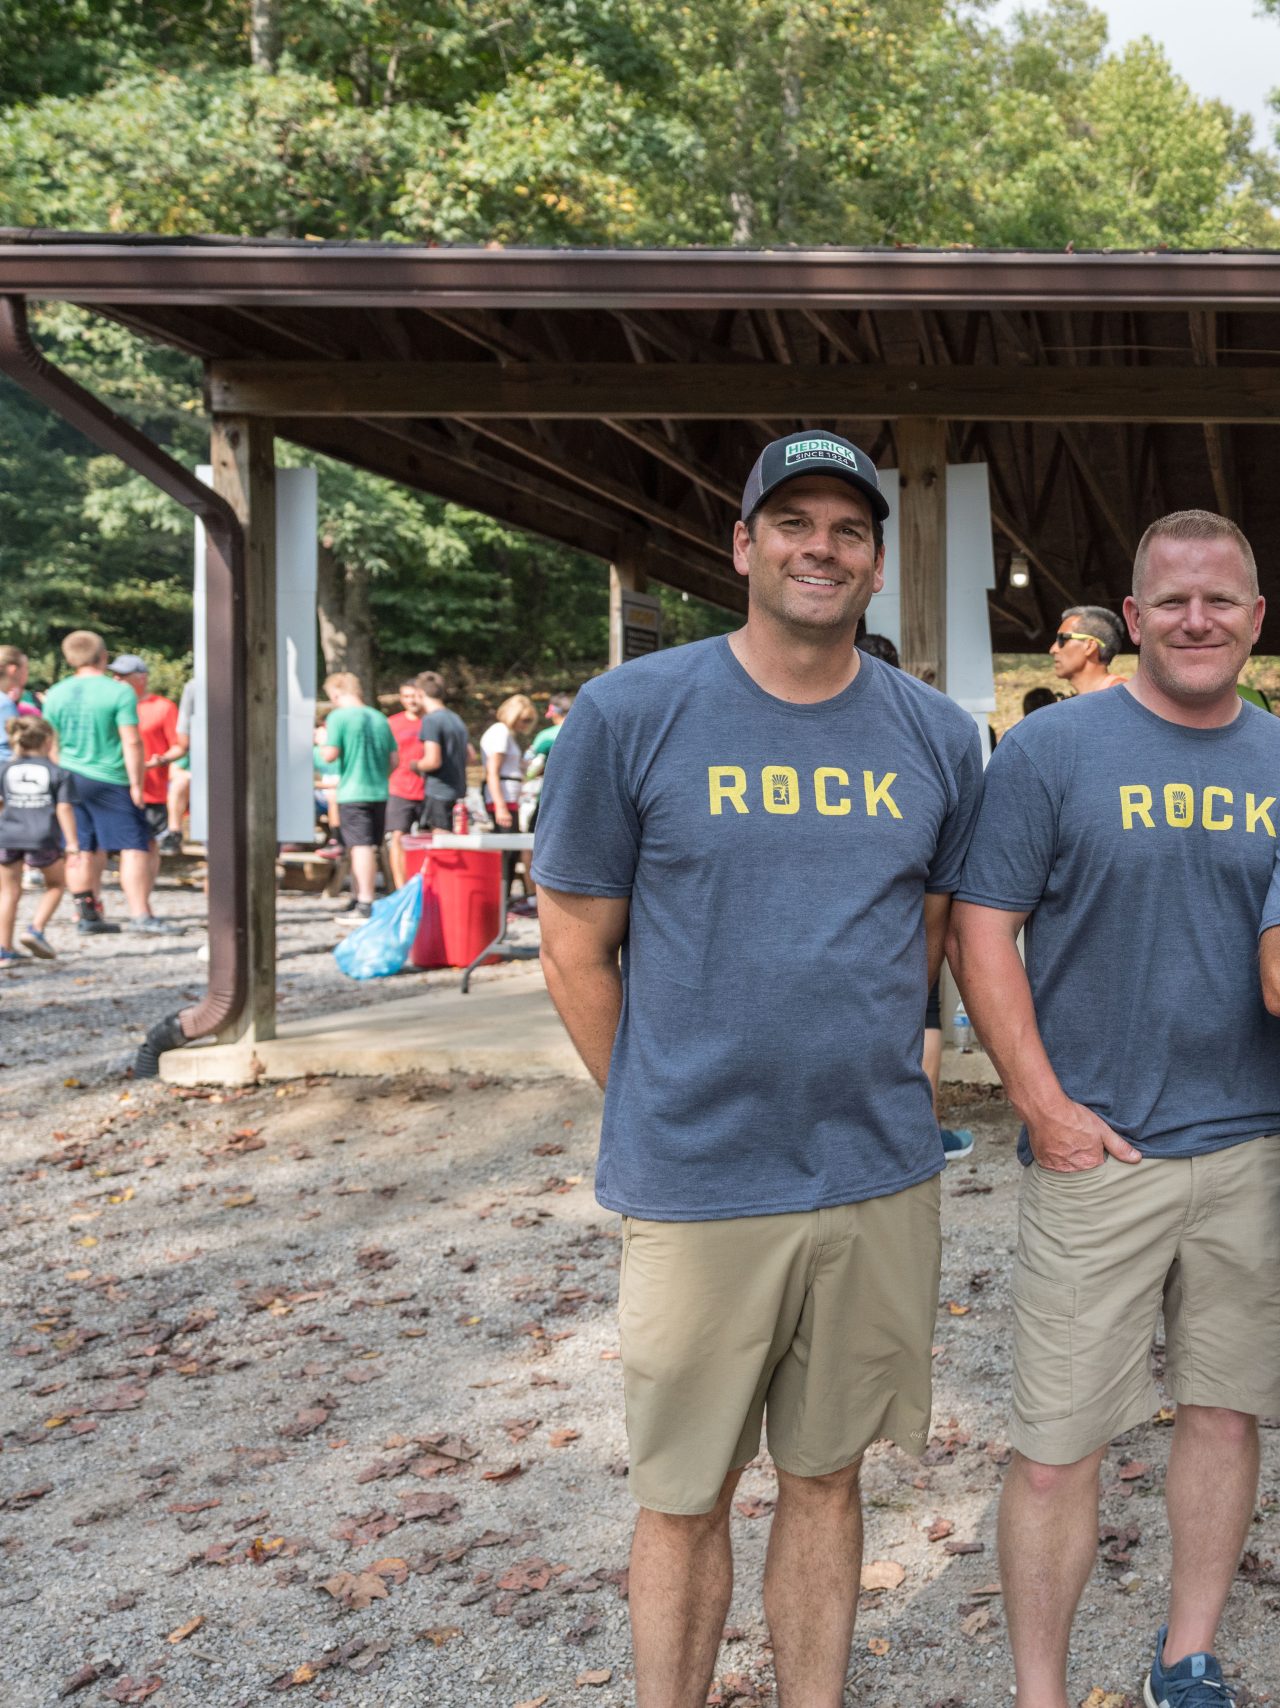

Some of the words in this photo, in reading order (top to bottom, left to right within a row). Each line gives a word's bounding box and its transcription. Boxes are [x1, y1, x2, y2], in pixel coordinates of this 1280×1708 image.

[788, 441, 853, 459] HEDRICK
[795, 451, 824, 461] SINCE
[826, 451, 849, 465] 1924
[708, 765, 904, 820] ROCK
[1119, 783, 1278, 838] ROCK
